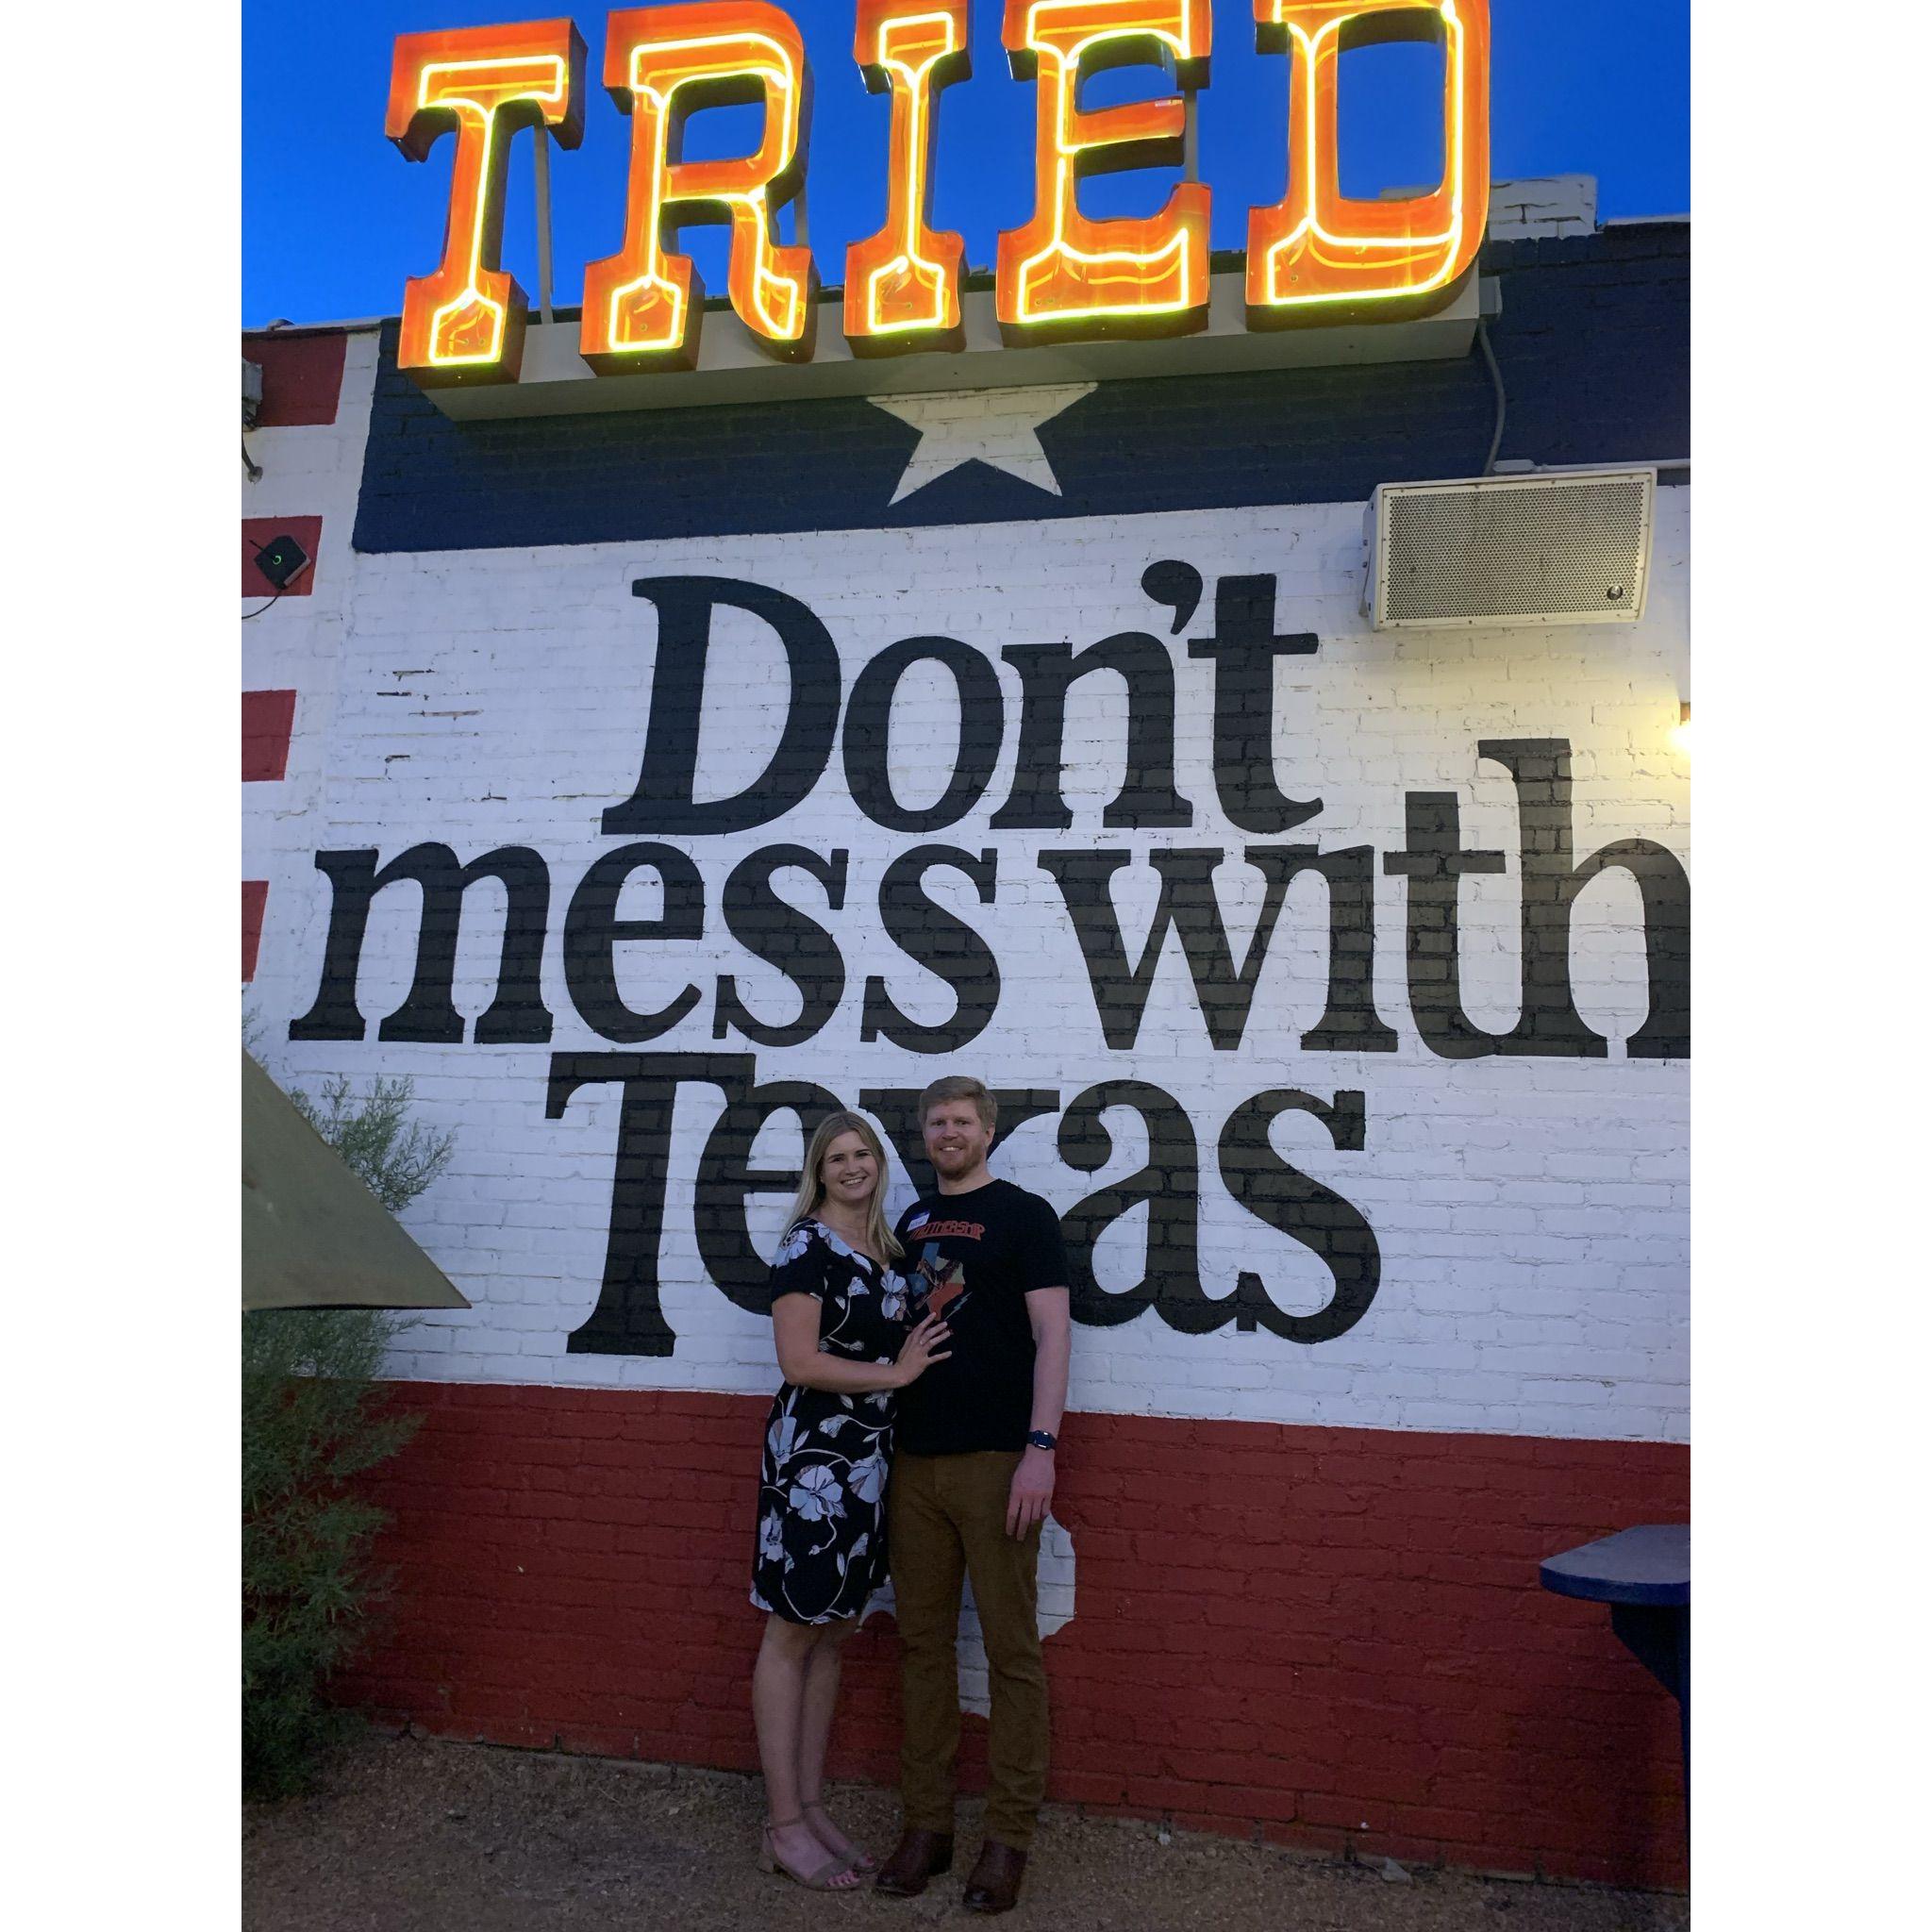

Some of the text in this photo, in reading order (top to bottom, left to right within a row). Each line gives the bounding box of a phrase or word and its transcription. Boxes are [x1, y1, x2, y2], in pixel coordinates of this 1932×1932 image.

[385, 0, 1492, 383] TRIED
[601, 559, 1323, 836] Don't
[288, 739, 1690, 1060] mess with
